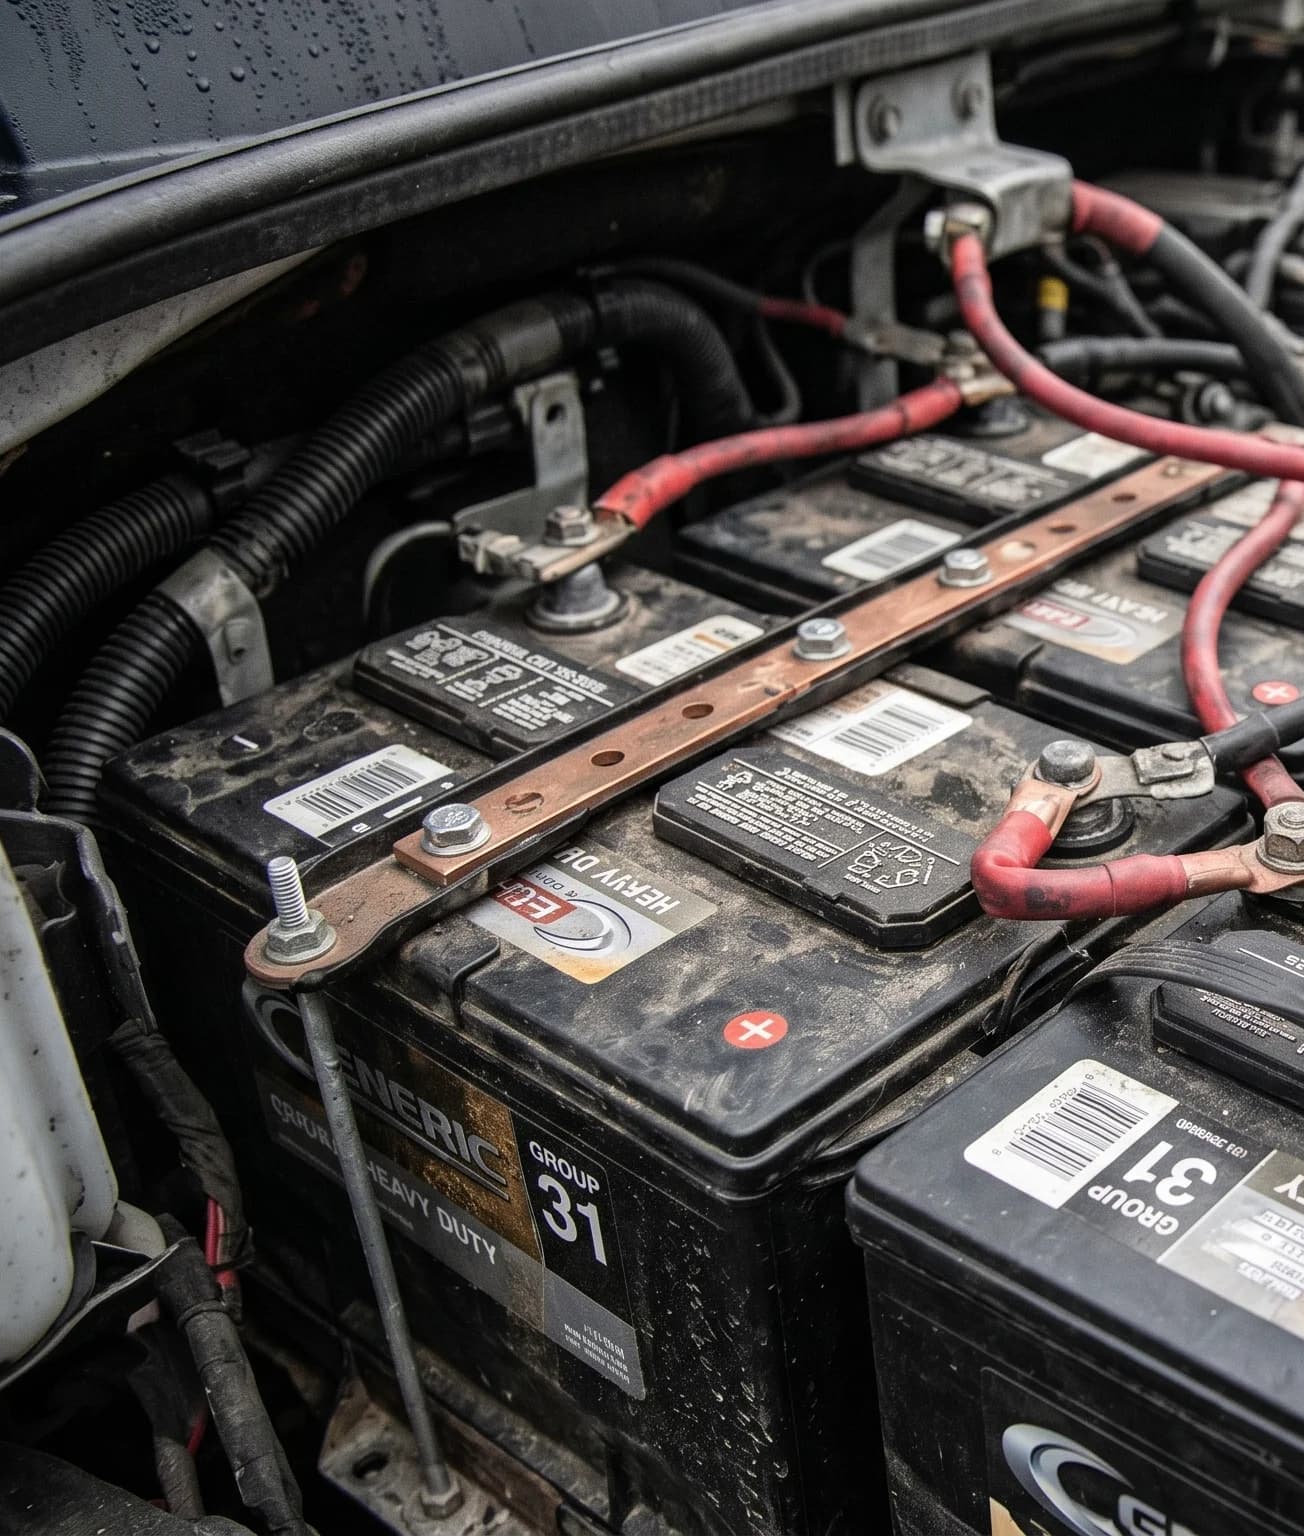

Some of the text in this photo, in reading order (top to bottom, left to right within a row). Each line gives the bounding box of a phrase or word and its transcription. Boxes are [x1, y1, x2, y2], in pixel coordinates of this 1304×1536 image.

[529, 1140, 601, 1194] GROUP
[1127, 1141, 1218, 1206] 31
[439, 1206, 497, 1266] DUTY
[537, 1173, 609, 1267] 31
[1086, 1185, 1181, 1237] GROUP
